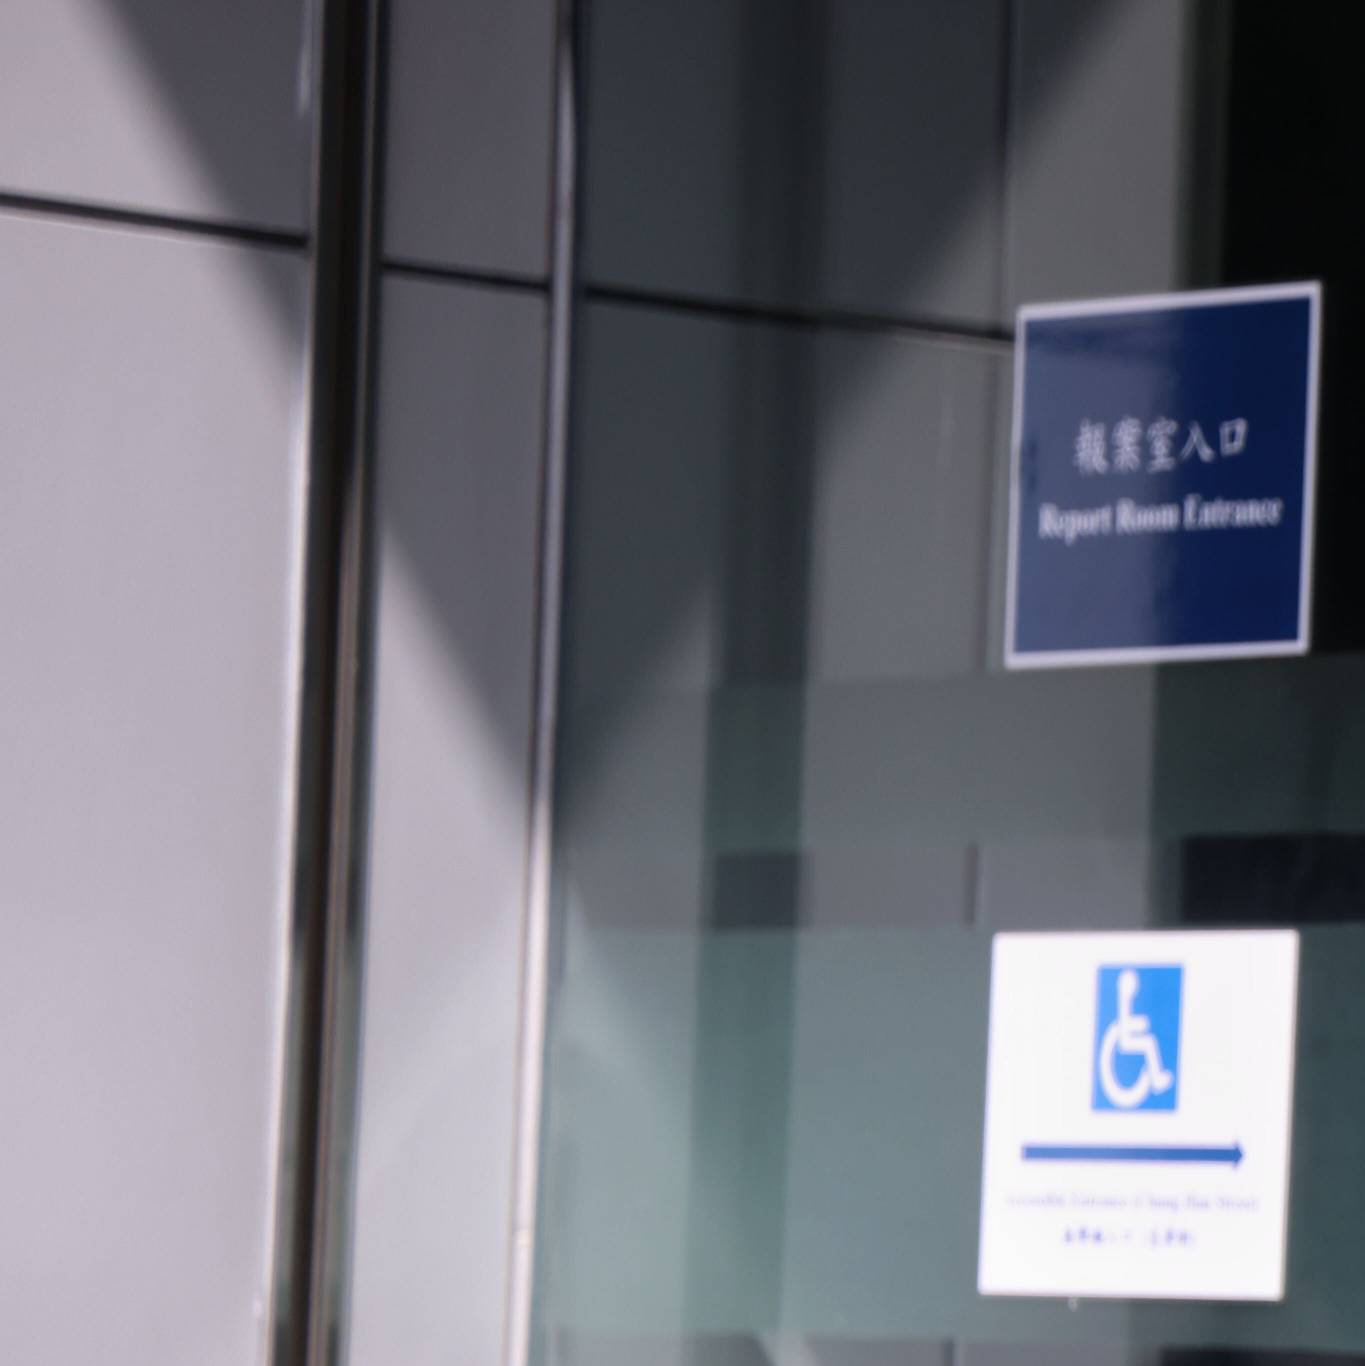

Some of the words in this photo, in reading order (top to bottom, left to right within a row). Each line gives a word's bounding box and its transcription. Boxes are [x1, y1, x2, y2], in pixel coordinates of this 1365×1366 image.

[1038, 503, 1113, 546] Report
[1116, 498, 1180, 536] Room
[1183, 494, 1284, 531] Entrance
